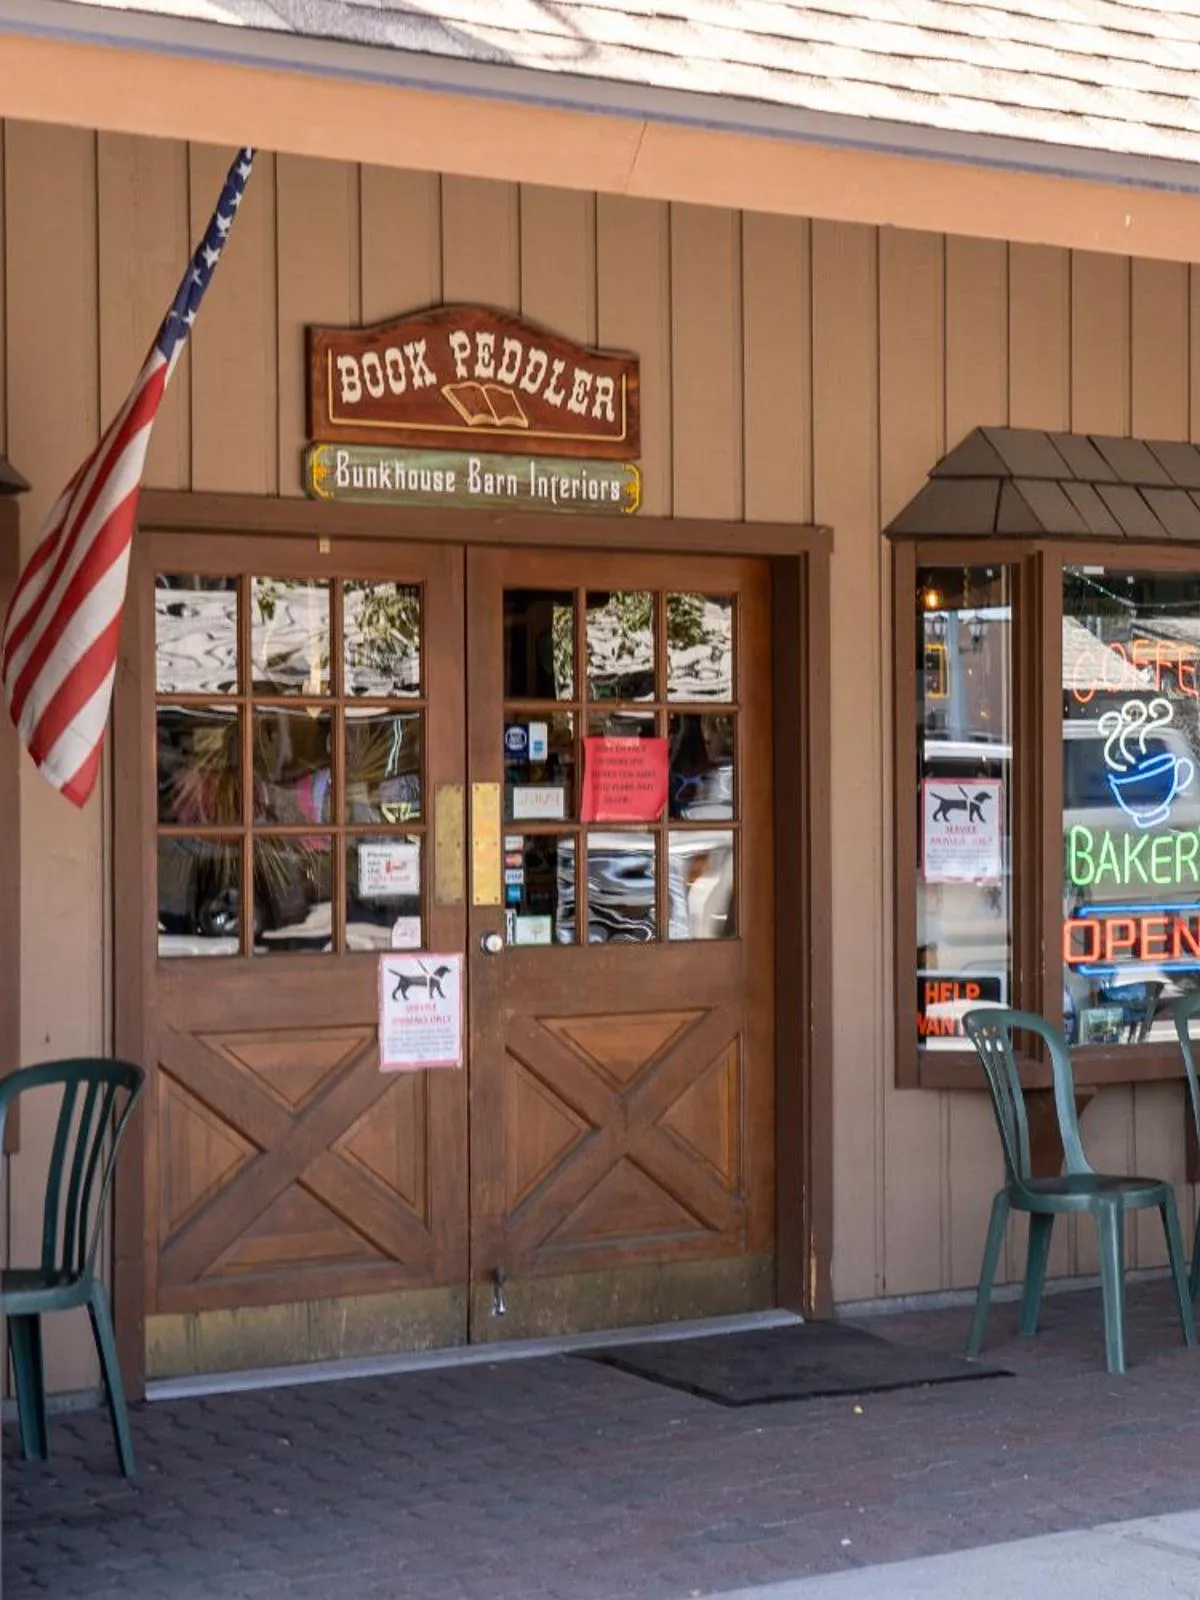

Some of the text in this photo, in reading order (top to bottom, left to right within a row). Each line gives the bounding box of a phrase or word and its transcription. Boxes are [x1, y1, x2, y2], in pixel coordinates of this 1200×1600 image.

[337, 330, 615, 422] BOOK PEDDLER
[336, 450, 621, 504] Bunkhouse Barn Interiors
[925, 981, 980, 1005] HELP
